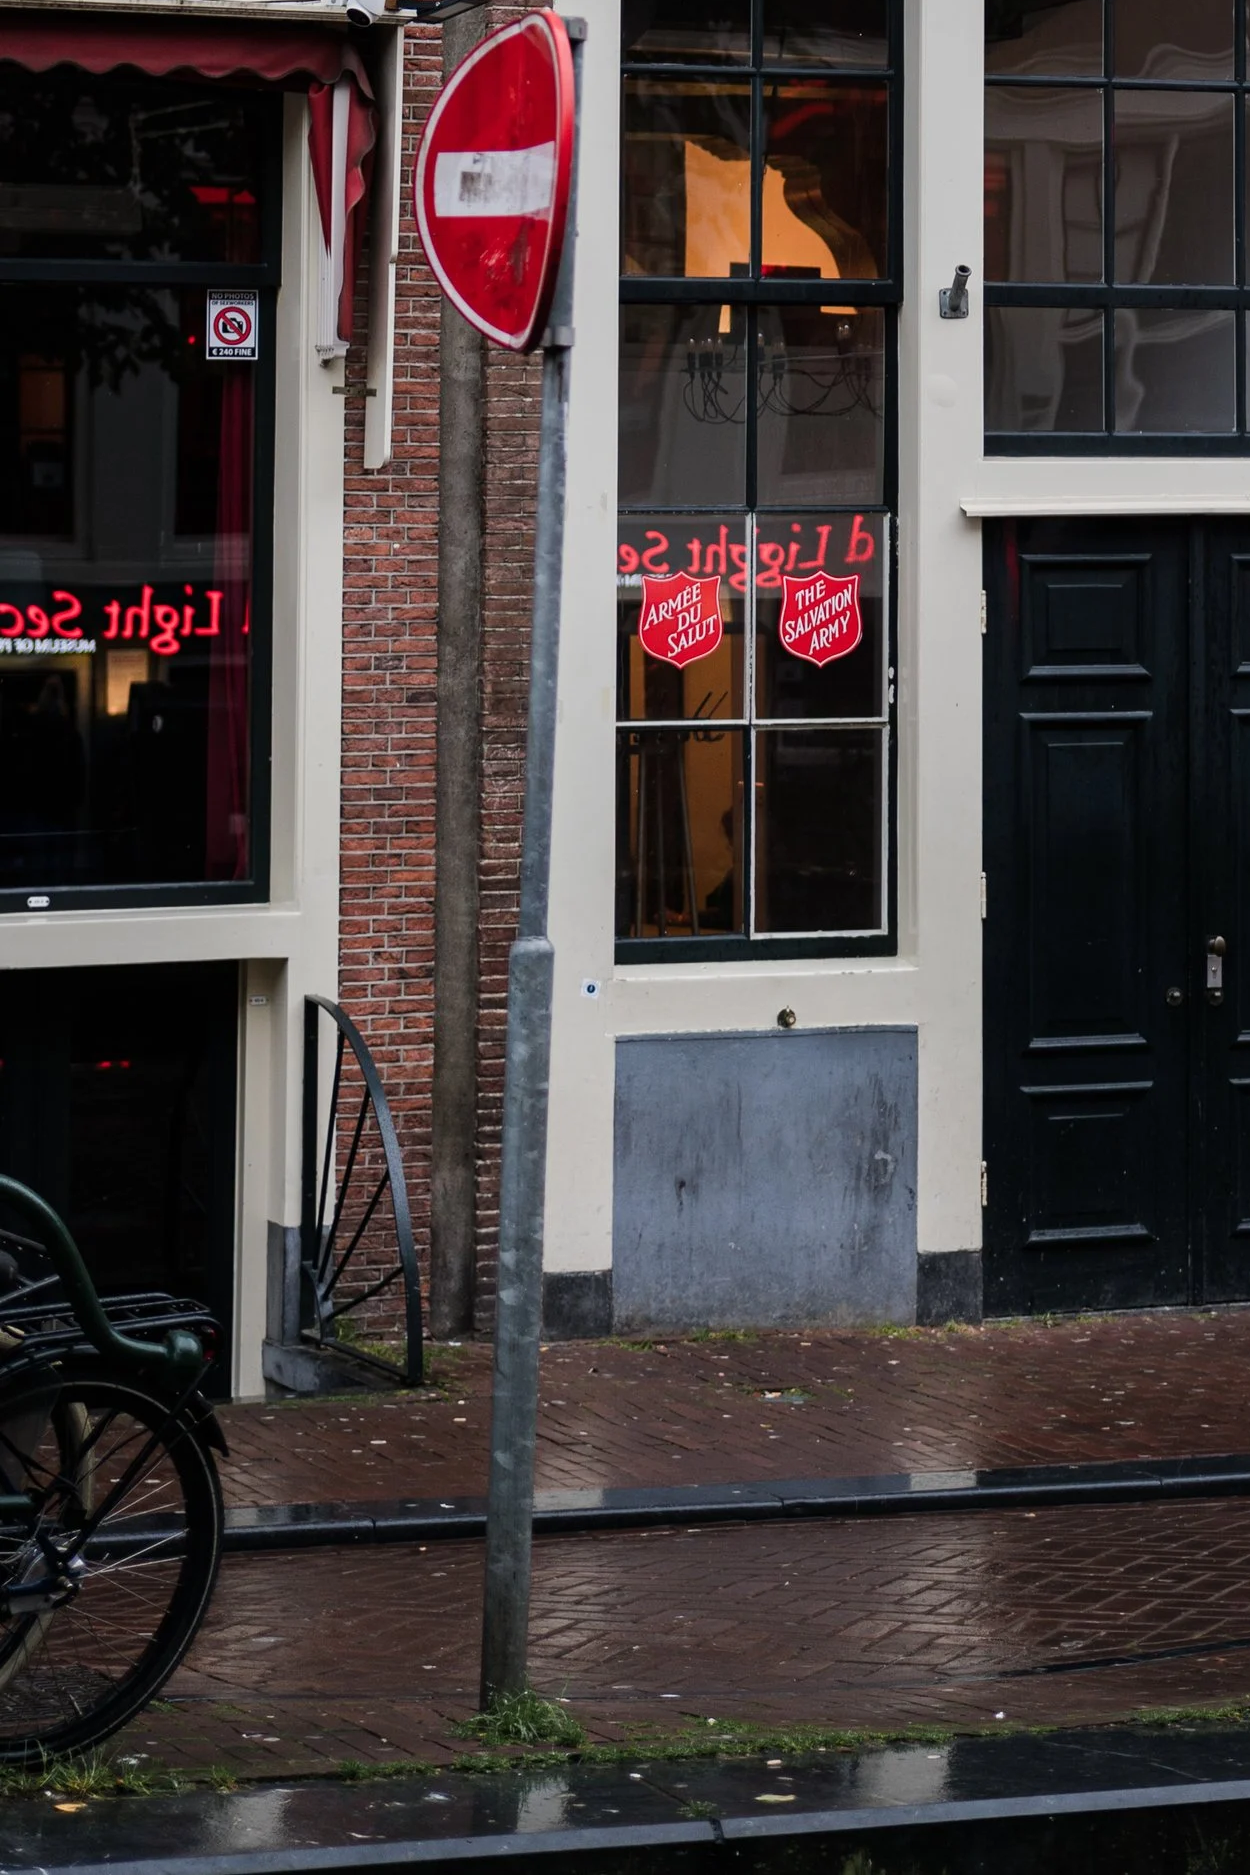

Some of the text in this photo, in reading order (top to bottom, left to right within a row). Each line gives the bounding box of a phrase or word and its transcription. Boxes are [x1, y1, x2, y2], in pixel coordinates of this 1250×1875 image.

[643, 582, 702, 631] ARMÉE
[784, 584, 852, 644] SALVATION
[795, 580, 826, 610] THE
[667, 614, 718, 658] SALUT
[677, 604, 702, 632] DU
[808, 611, 851, 656] ARMY
